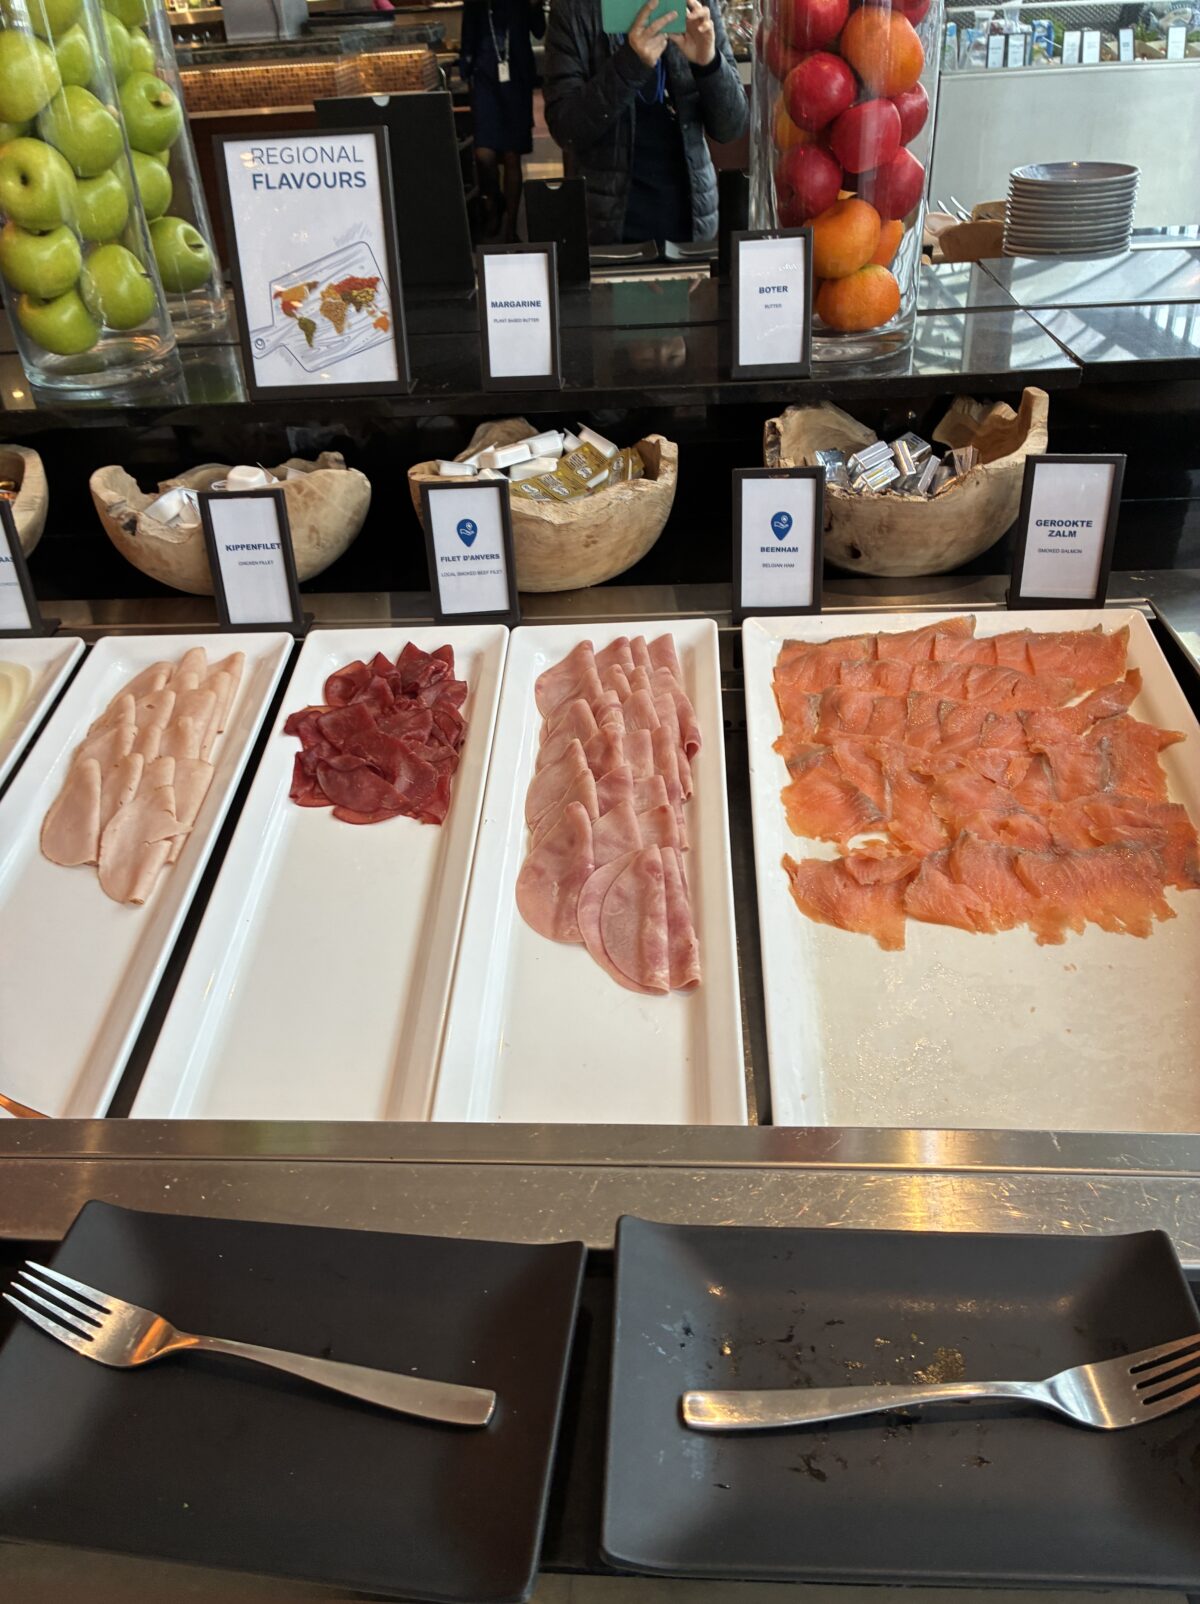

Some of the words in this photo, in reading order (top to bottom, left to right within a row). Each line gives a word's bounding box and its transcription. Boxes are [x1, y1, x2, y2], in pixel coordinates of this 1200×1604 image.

[250, 146, 364, 165] REGIONAL
[252, 171, 366, 190] FLAVOURS
[758, 285, 789, 294] BOTER
[491, 300, 542, 308] MARGARINE
[1035, 519, 1093, 528] GEROOKTE
[1047, 530, 1077, 538] ZALM
[225, 542, 281, 552] KIPPENFILET
[440, 555, 461, 563] FILET
[463, 553, 500, 561] D'ANVERS
